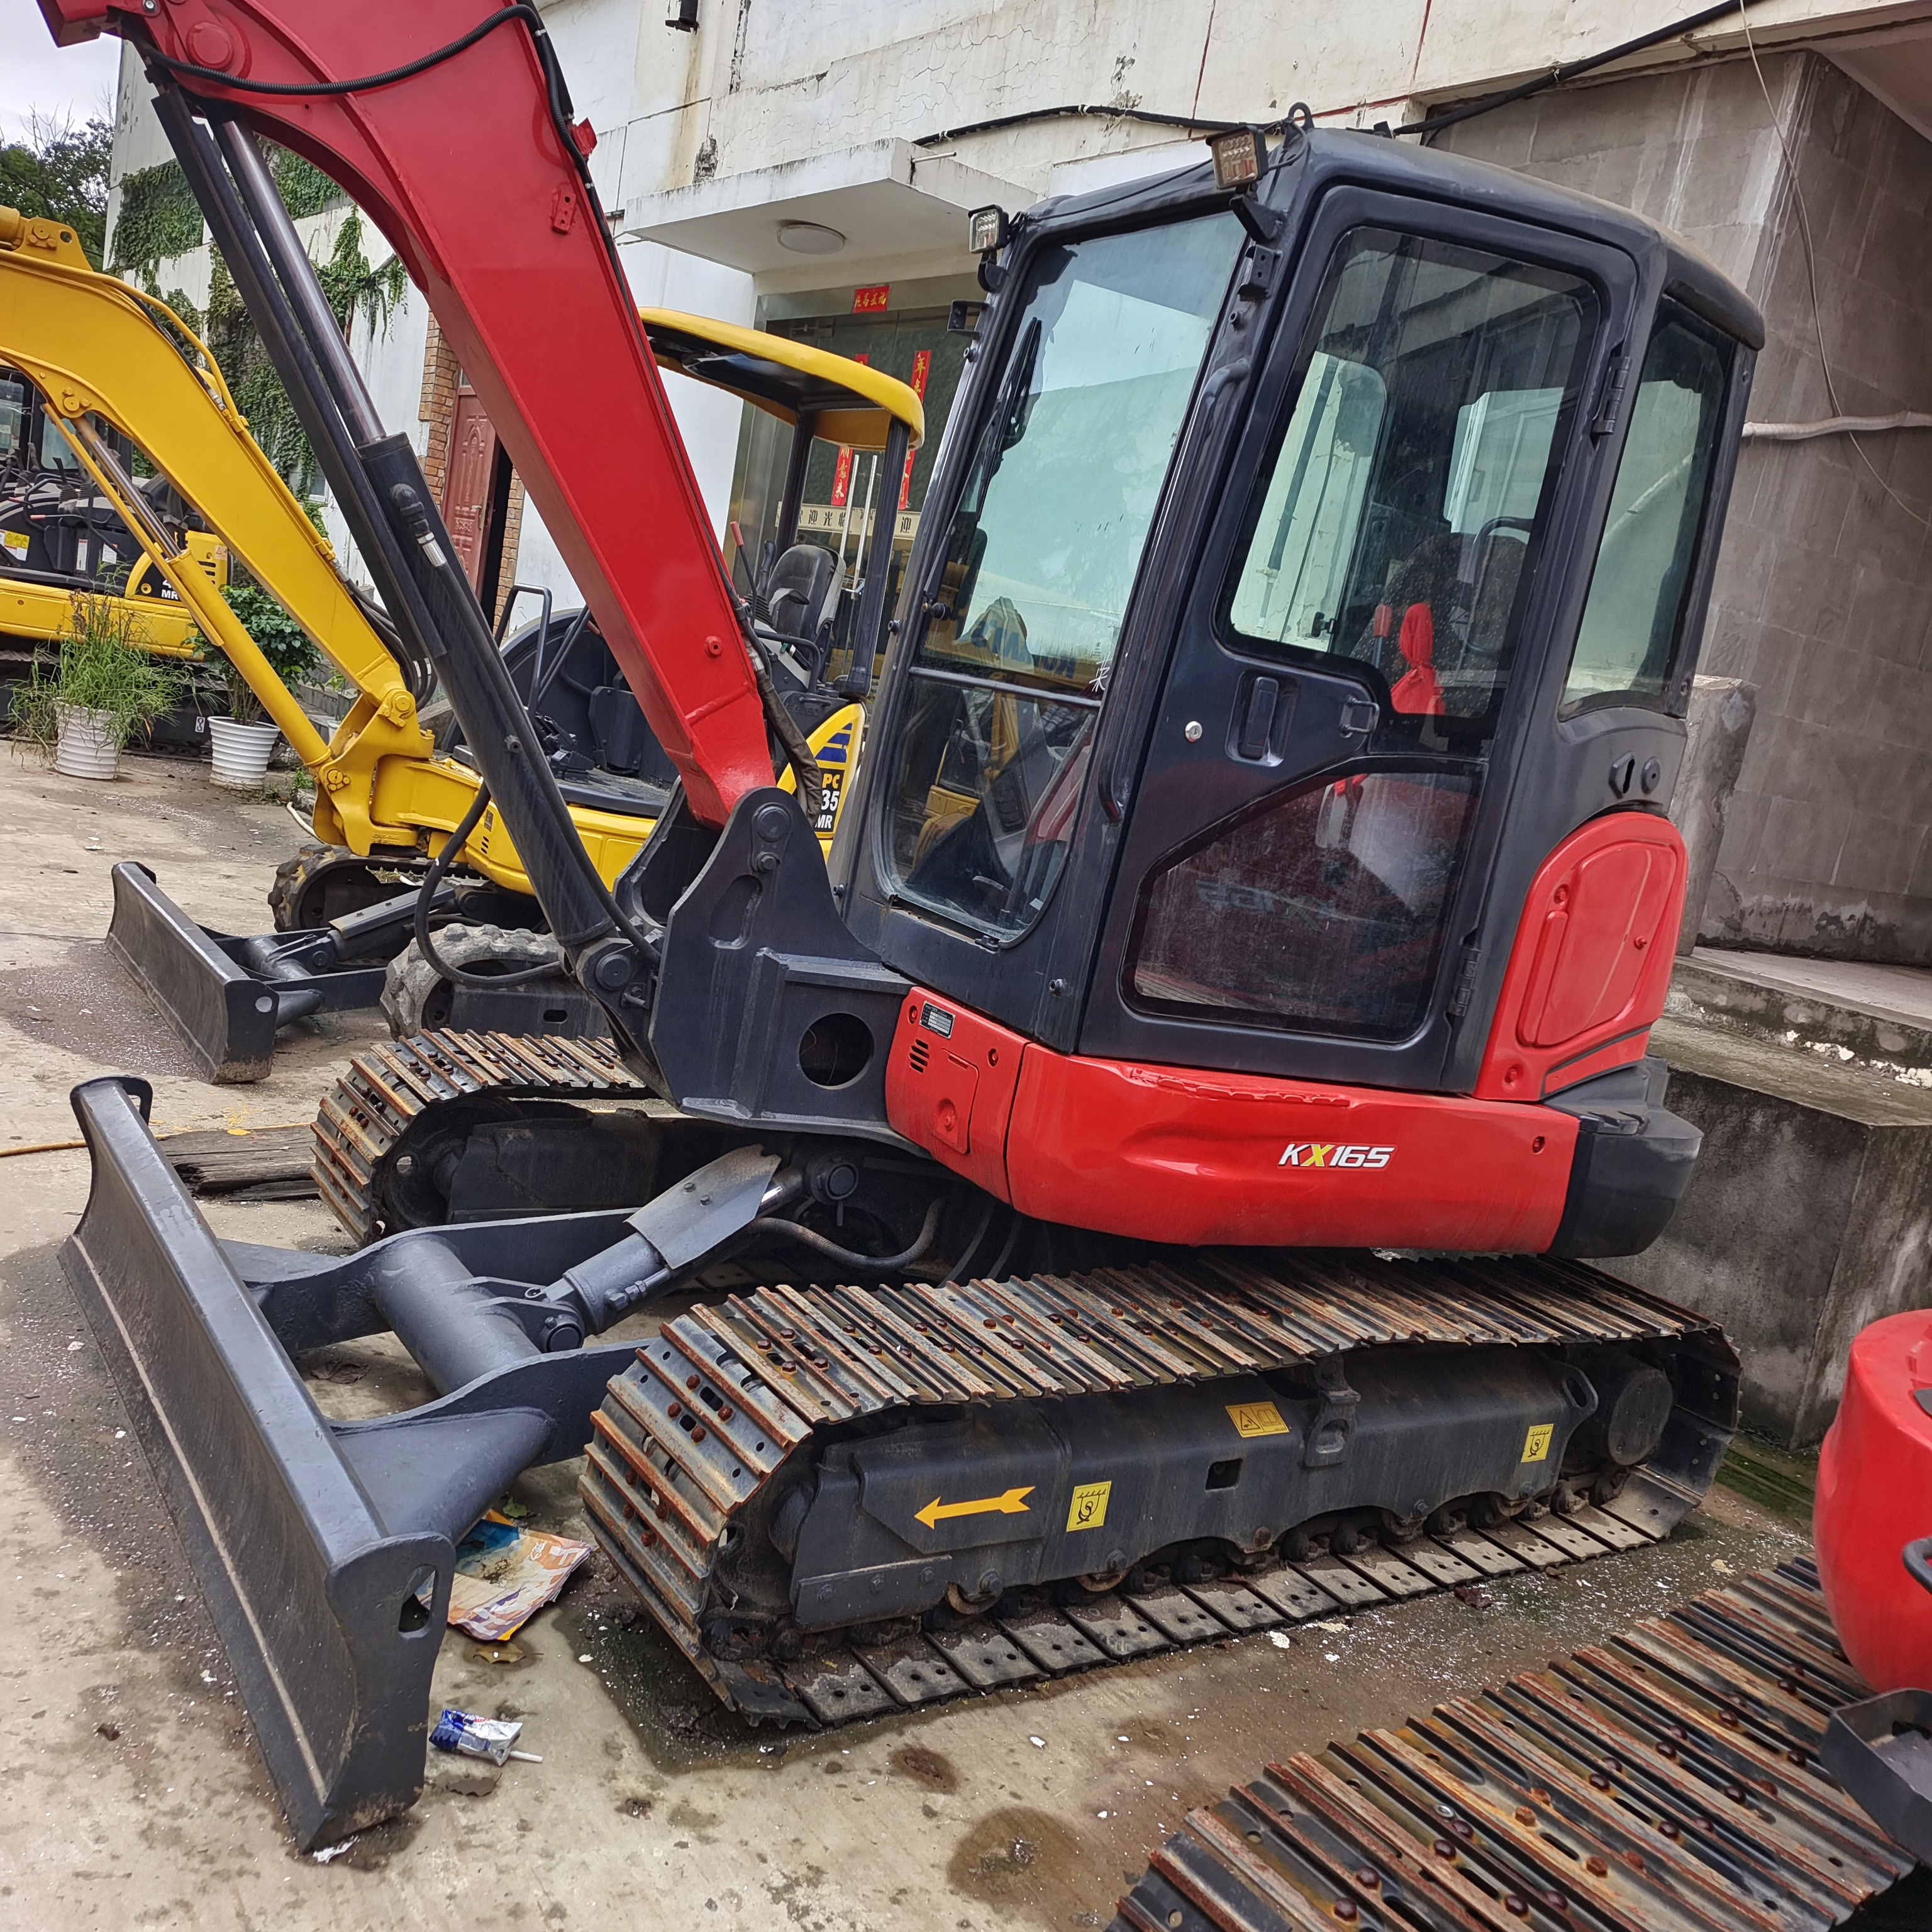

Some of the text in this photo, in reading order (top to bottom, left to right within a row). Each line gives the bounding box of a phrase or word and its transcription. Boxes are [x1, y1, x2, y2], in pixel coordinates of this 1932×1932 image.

[822, 774, 840, 789] PC
[821, 789, 840, 812] 35
[1278, 1143, 1396, 1169] KX165
